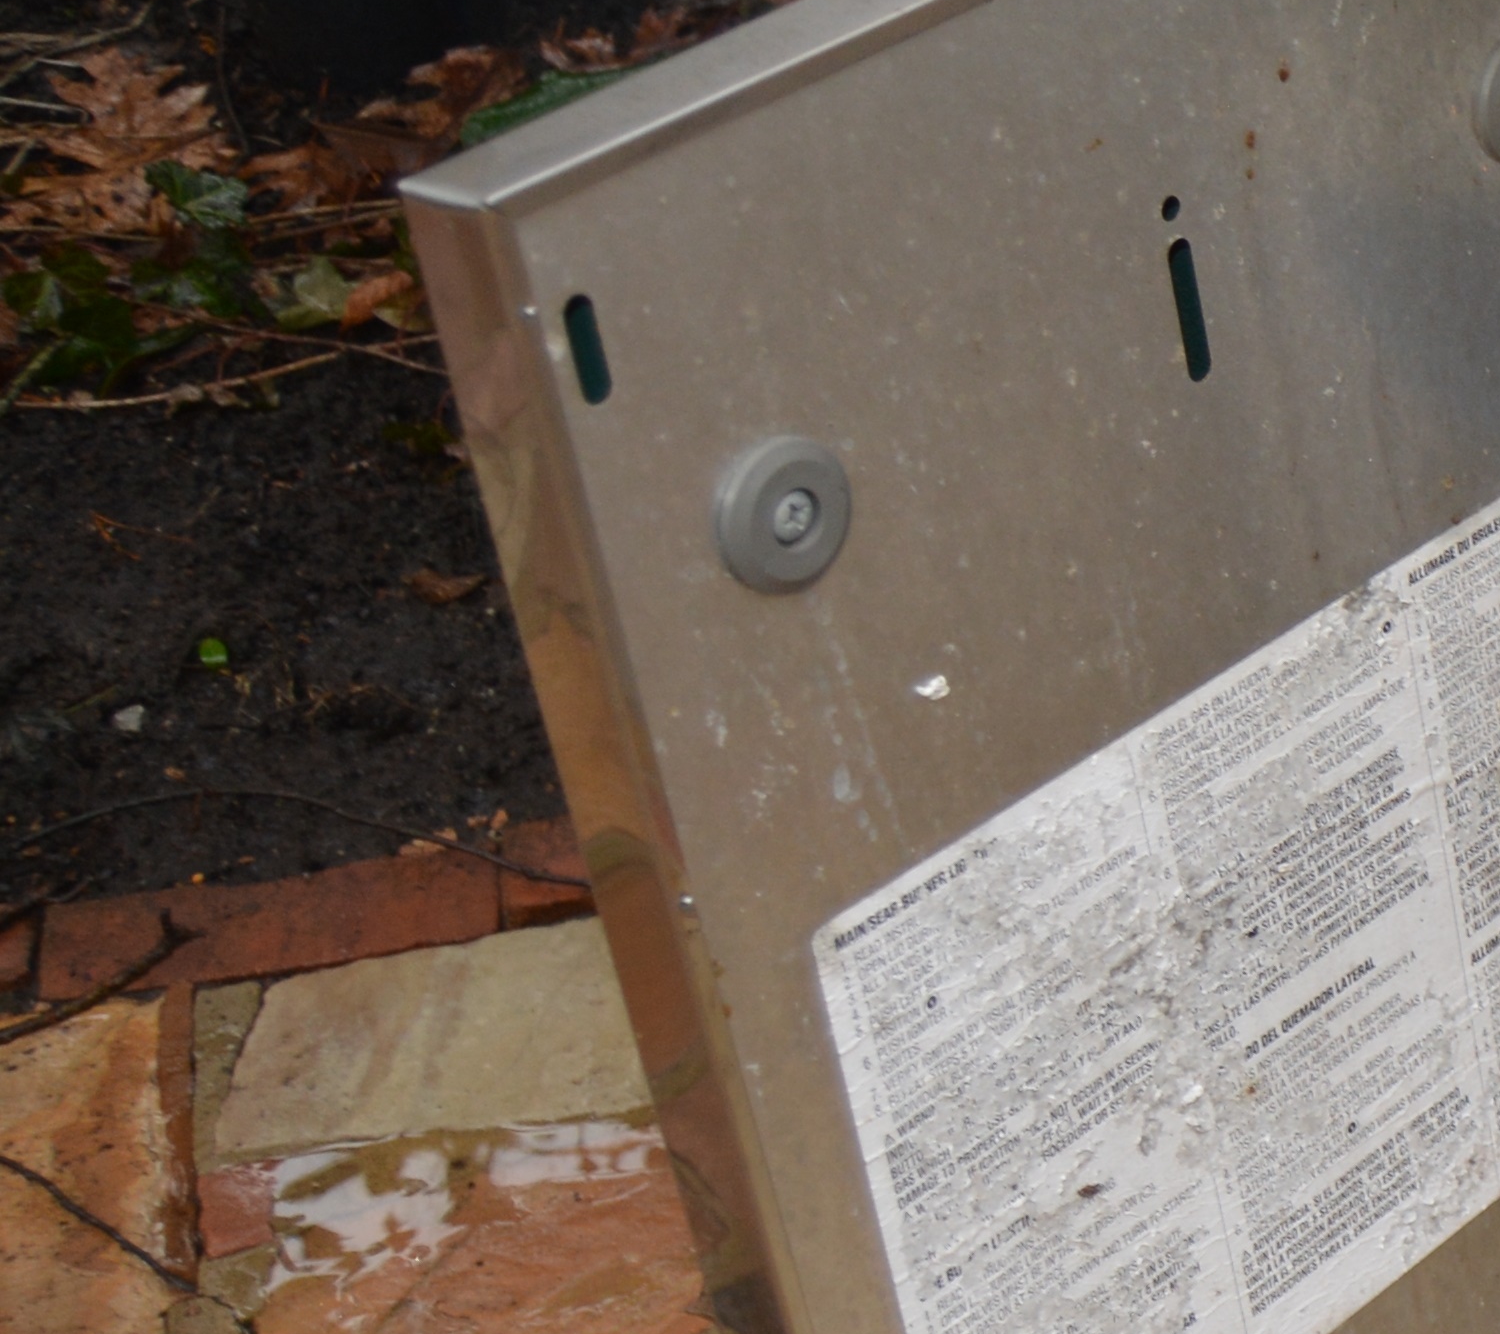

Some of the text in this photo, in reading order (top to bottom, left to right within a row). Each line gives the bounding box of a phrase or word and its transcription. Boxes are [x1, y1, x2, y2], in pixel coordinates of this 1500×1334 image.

[1407, 545, 1456, 586] ALLUMAGE
[1458, 536, 1470, 554] DU
[1347, 745, 1398, 790] ENCENDERSE
[1268, 786, 1410, 894] GAS PUEDE CAUSAR LESIONES
[1468, 850, 1487, 873] MISE
[1271, 823, 1405, 925] EL ENCENDIDO NO OCURRIESE EN
[1295, 860, 1374, 925] CONTROLES DE LOS
[1242, 895, 1277, 928] GRAVES
[1243, 878, 1415, 1011] LAS ENCENDER CON
[1261, 954, 1375, 1048] DEL QUEMADOR LATERAL
[920, 1029, 965, 1068] IGNITION
[1256, 1016, 1323, 1075] INSTRUCCIONES
[1288, 1033, 1345, 1084] TAPA ABIERTA
[1321, 1026, 1376, 1076] DEBEN ESTAR
[977, 1067, 1115, 1173] IGNITION NOT OCCUR IN
[1077, 1095, 1100, 1120] WAIT
[1271, 1093, 1470, 1256] LAPSO CADA
[1313, 1086, 1460, 1208] SI EL ENCENDIDO NO DENTRO
[897, 1171, 941, 1212] DAMAGE
[1246, 1190, 1365, 1291] UNO APAGADO
[1248, 1209, 1359, 1304] REPITA PROCEDIMIENTO
[1251, 1193, 1399, 1319] INSTRUCCIONES PARA EL ENCENDIDO
[963, 1293, 1001, 1329] VALVES
